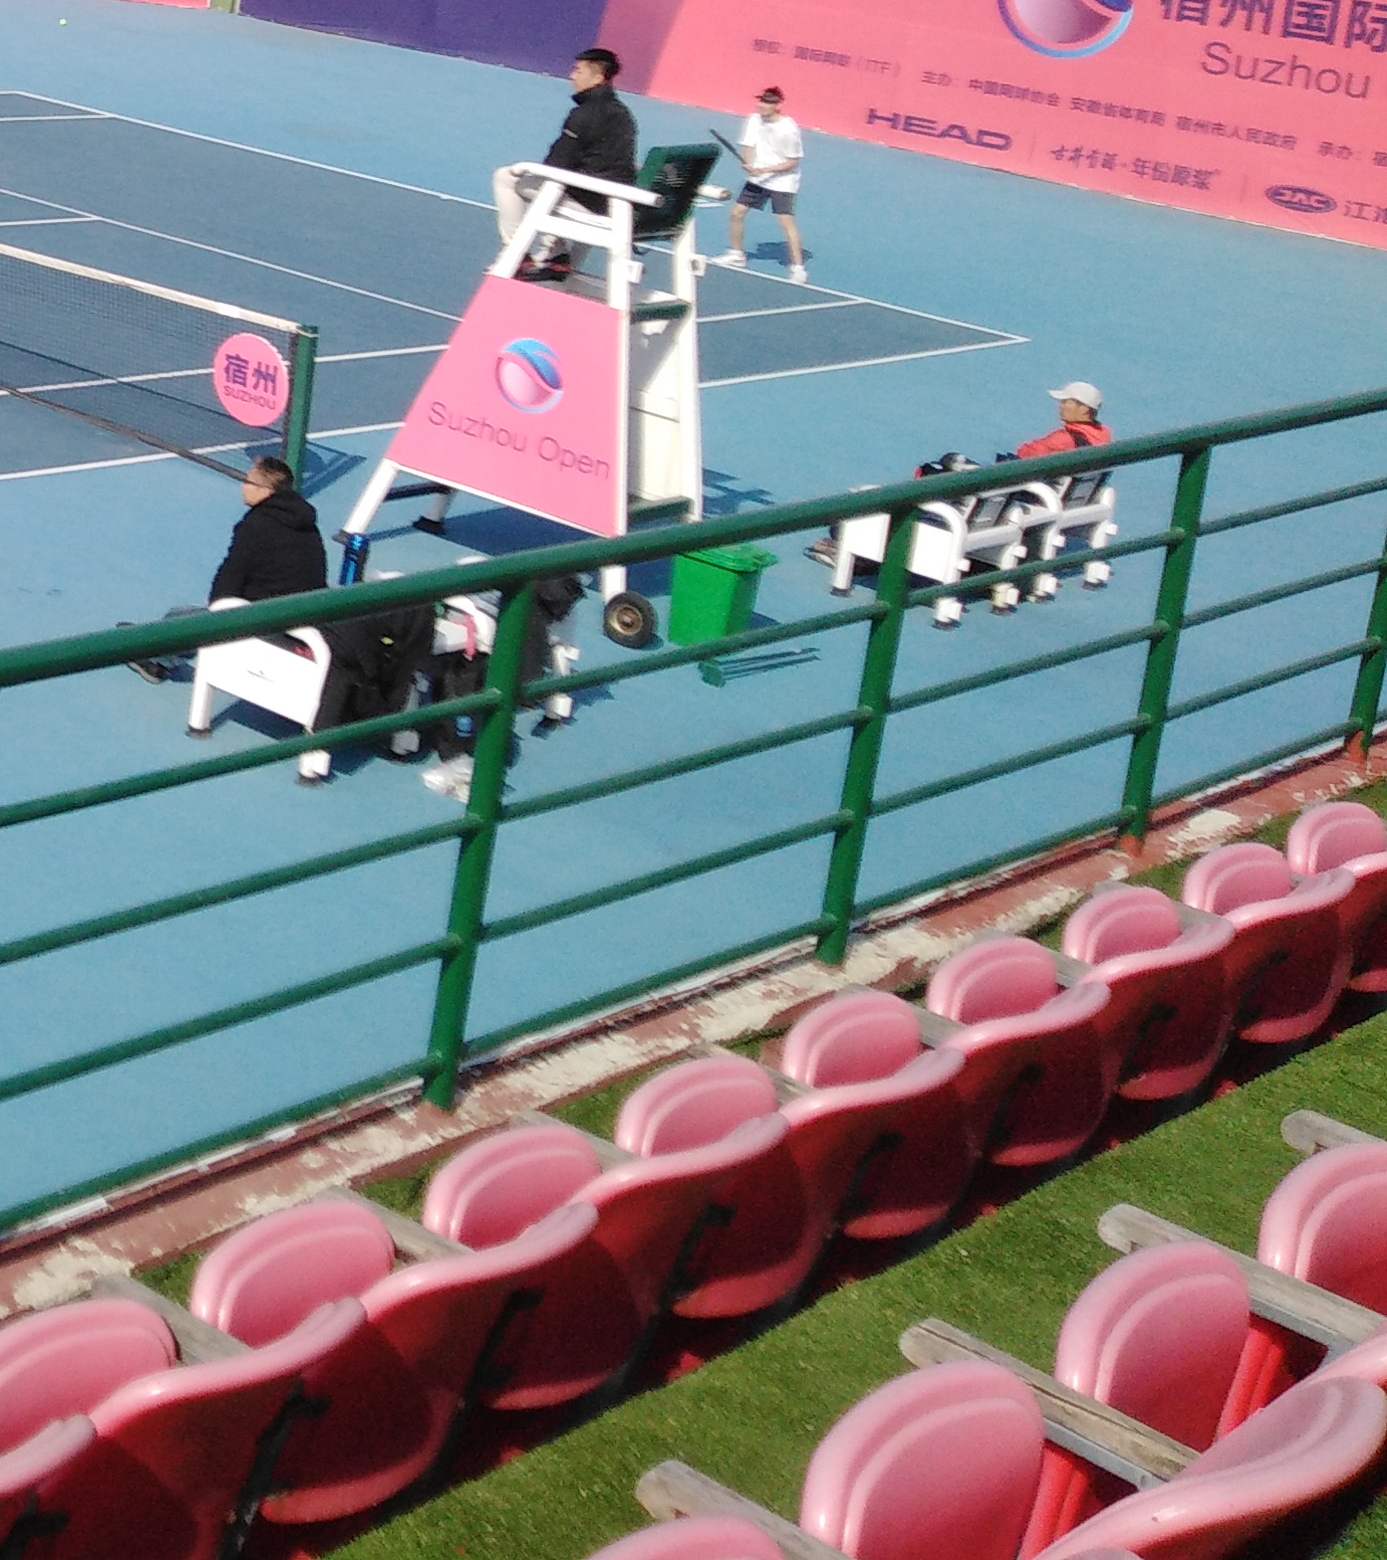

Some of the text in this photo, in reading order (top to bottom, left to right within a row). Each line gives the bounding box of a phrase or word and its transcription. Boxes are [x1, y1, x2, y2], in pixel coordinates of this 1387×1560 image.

[1201, 41, 1371, 99] Suzhou
[866, 107, 1013, 152] HEAD
[223, 352, 278, 396] 宿州
[427, 400, 611, 480] Suzhou Open
